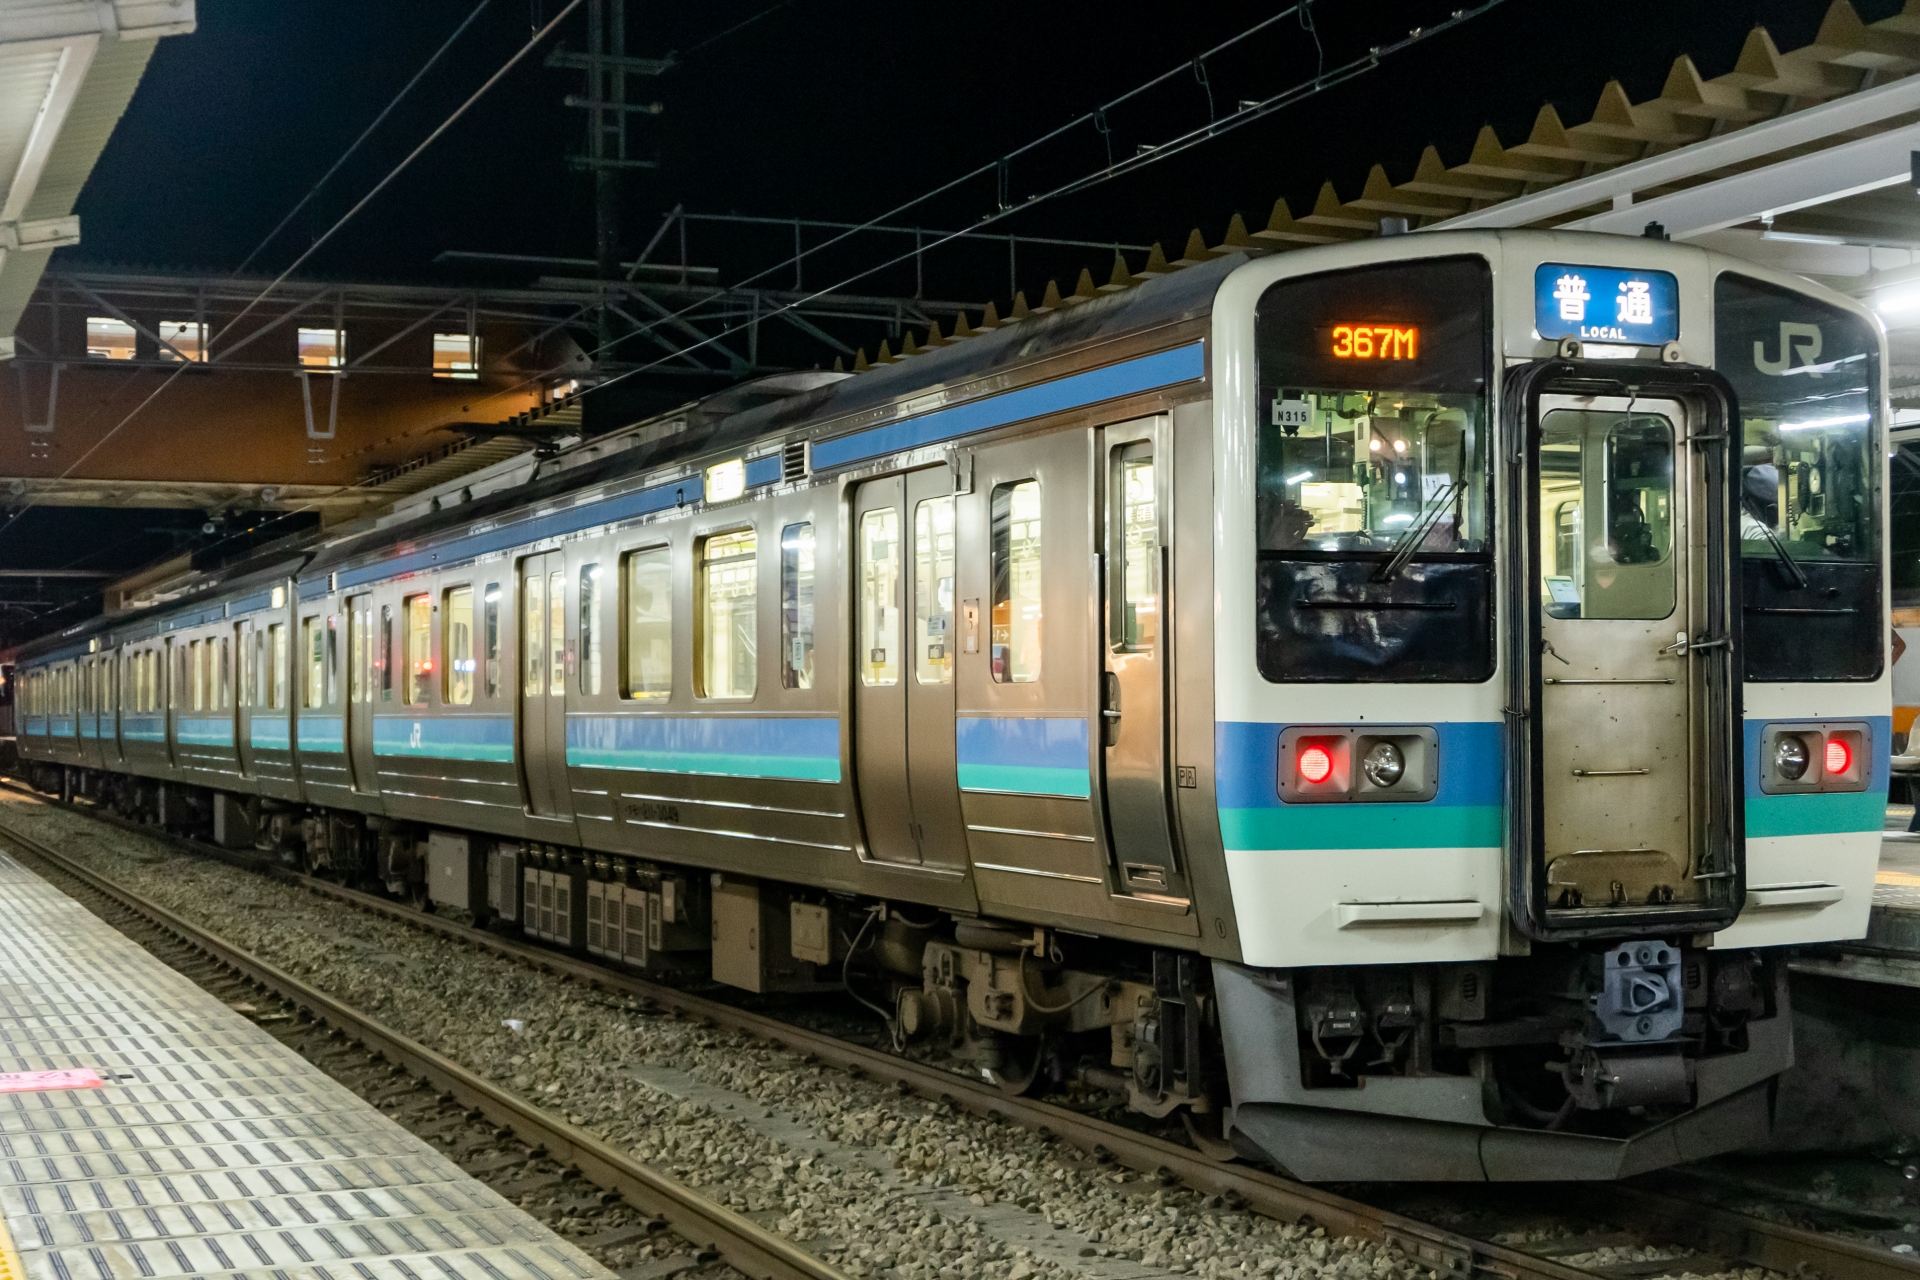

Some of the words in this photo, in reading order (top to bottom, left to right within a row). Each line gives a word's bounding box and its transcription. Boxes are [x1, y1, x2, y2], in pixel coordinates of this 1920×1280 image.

[1553, 274, 1653, 324] 普通
[1332, 326, 1414, 359] 367M
[1580, 325, 1627, 340] LOCAL
[1753, 321, 1824, 379] JR
[1277, 410, 1307, 422] N315
[409, 722, 422, 749] JR
